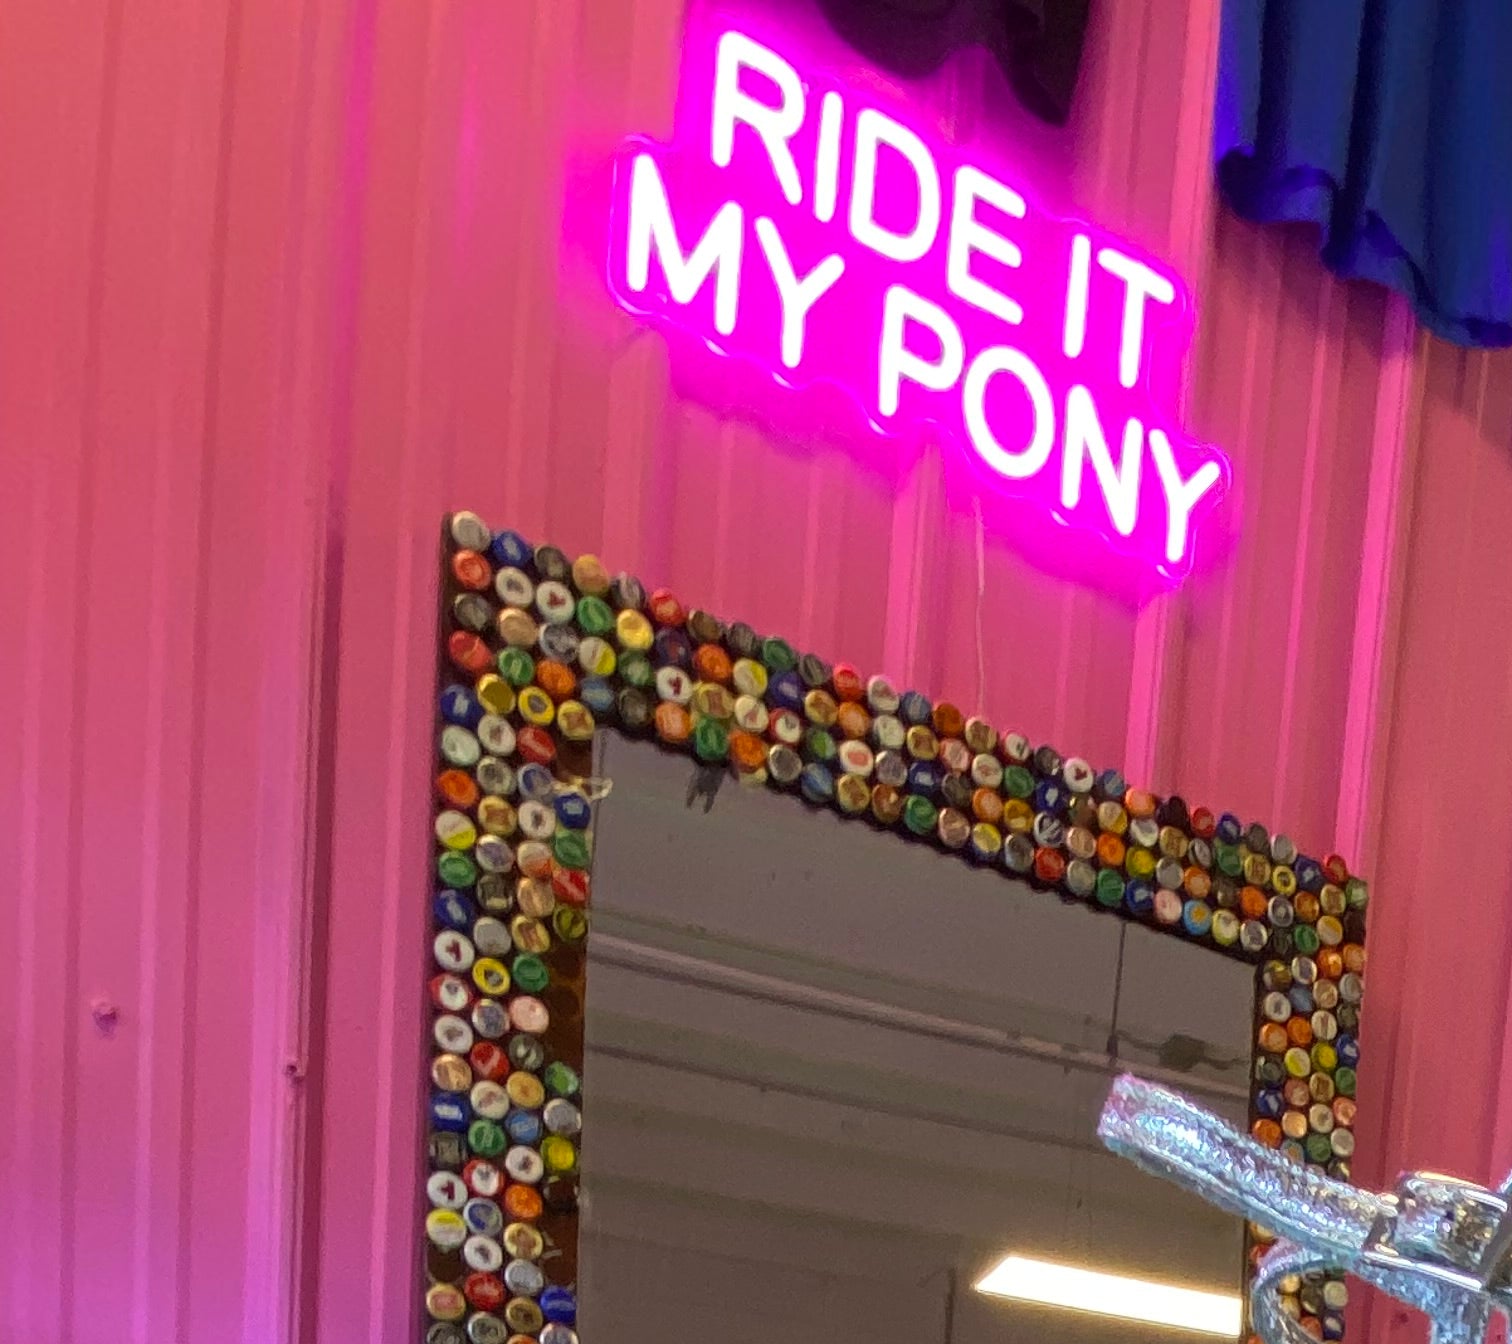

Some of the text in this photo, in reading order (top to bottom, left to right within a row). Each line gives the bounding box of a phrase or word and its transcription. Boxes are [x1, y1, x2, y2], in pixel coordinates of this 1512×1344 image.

[626, 153, 1221, 563] MY PONY
[711, 30, 1175, 388] RIDE IT
